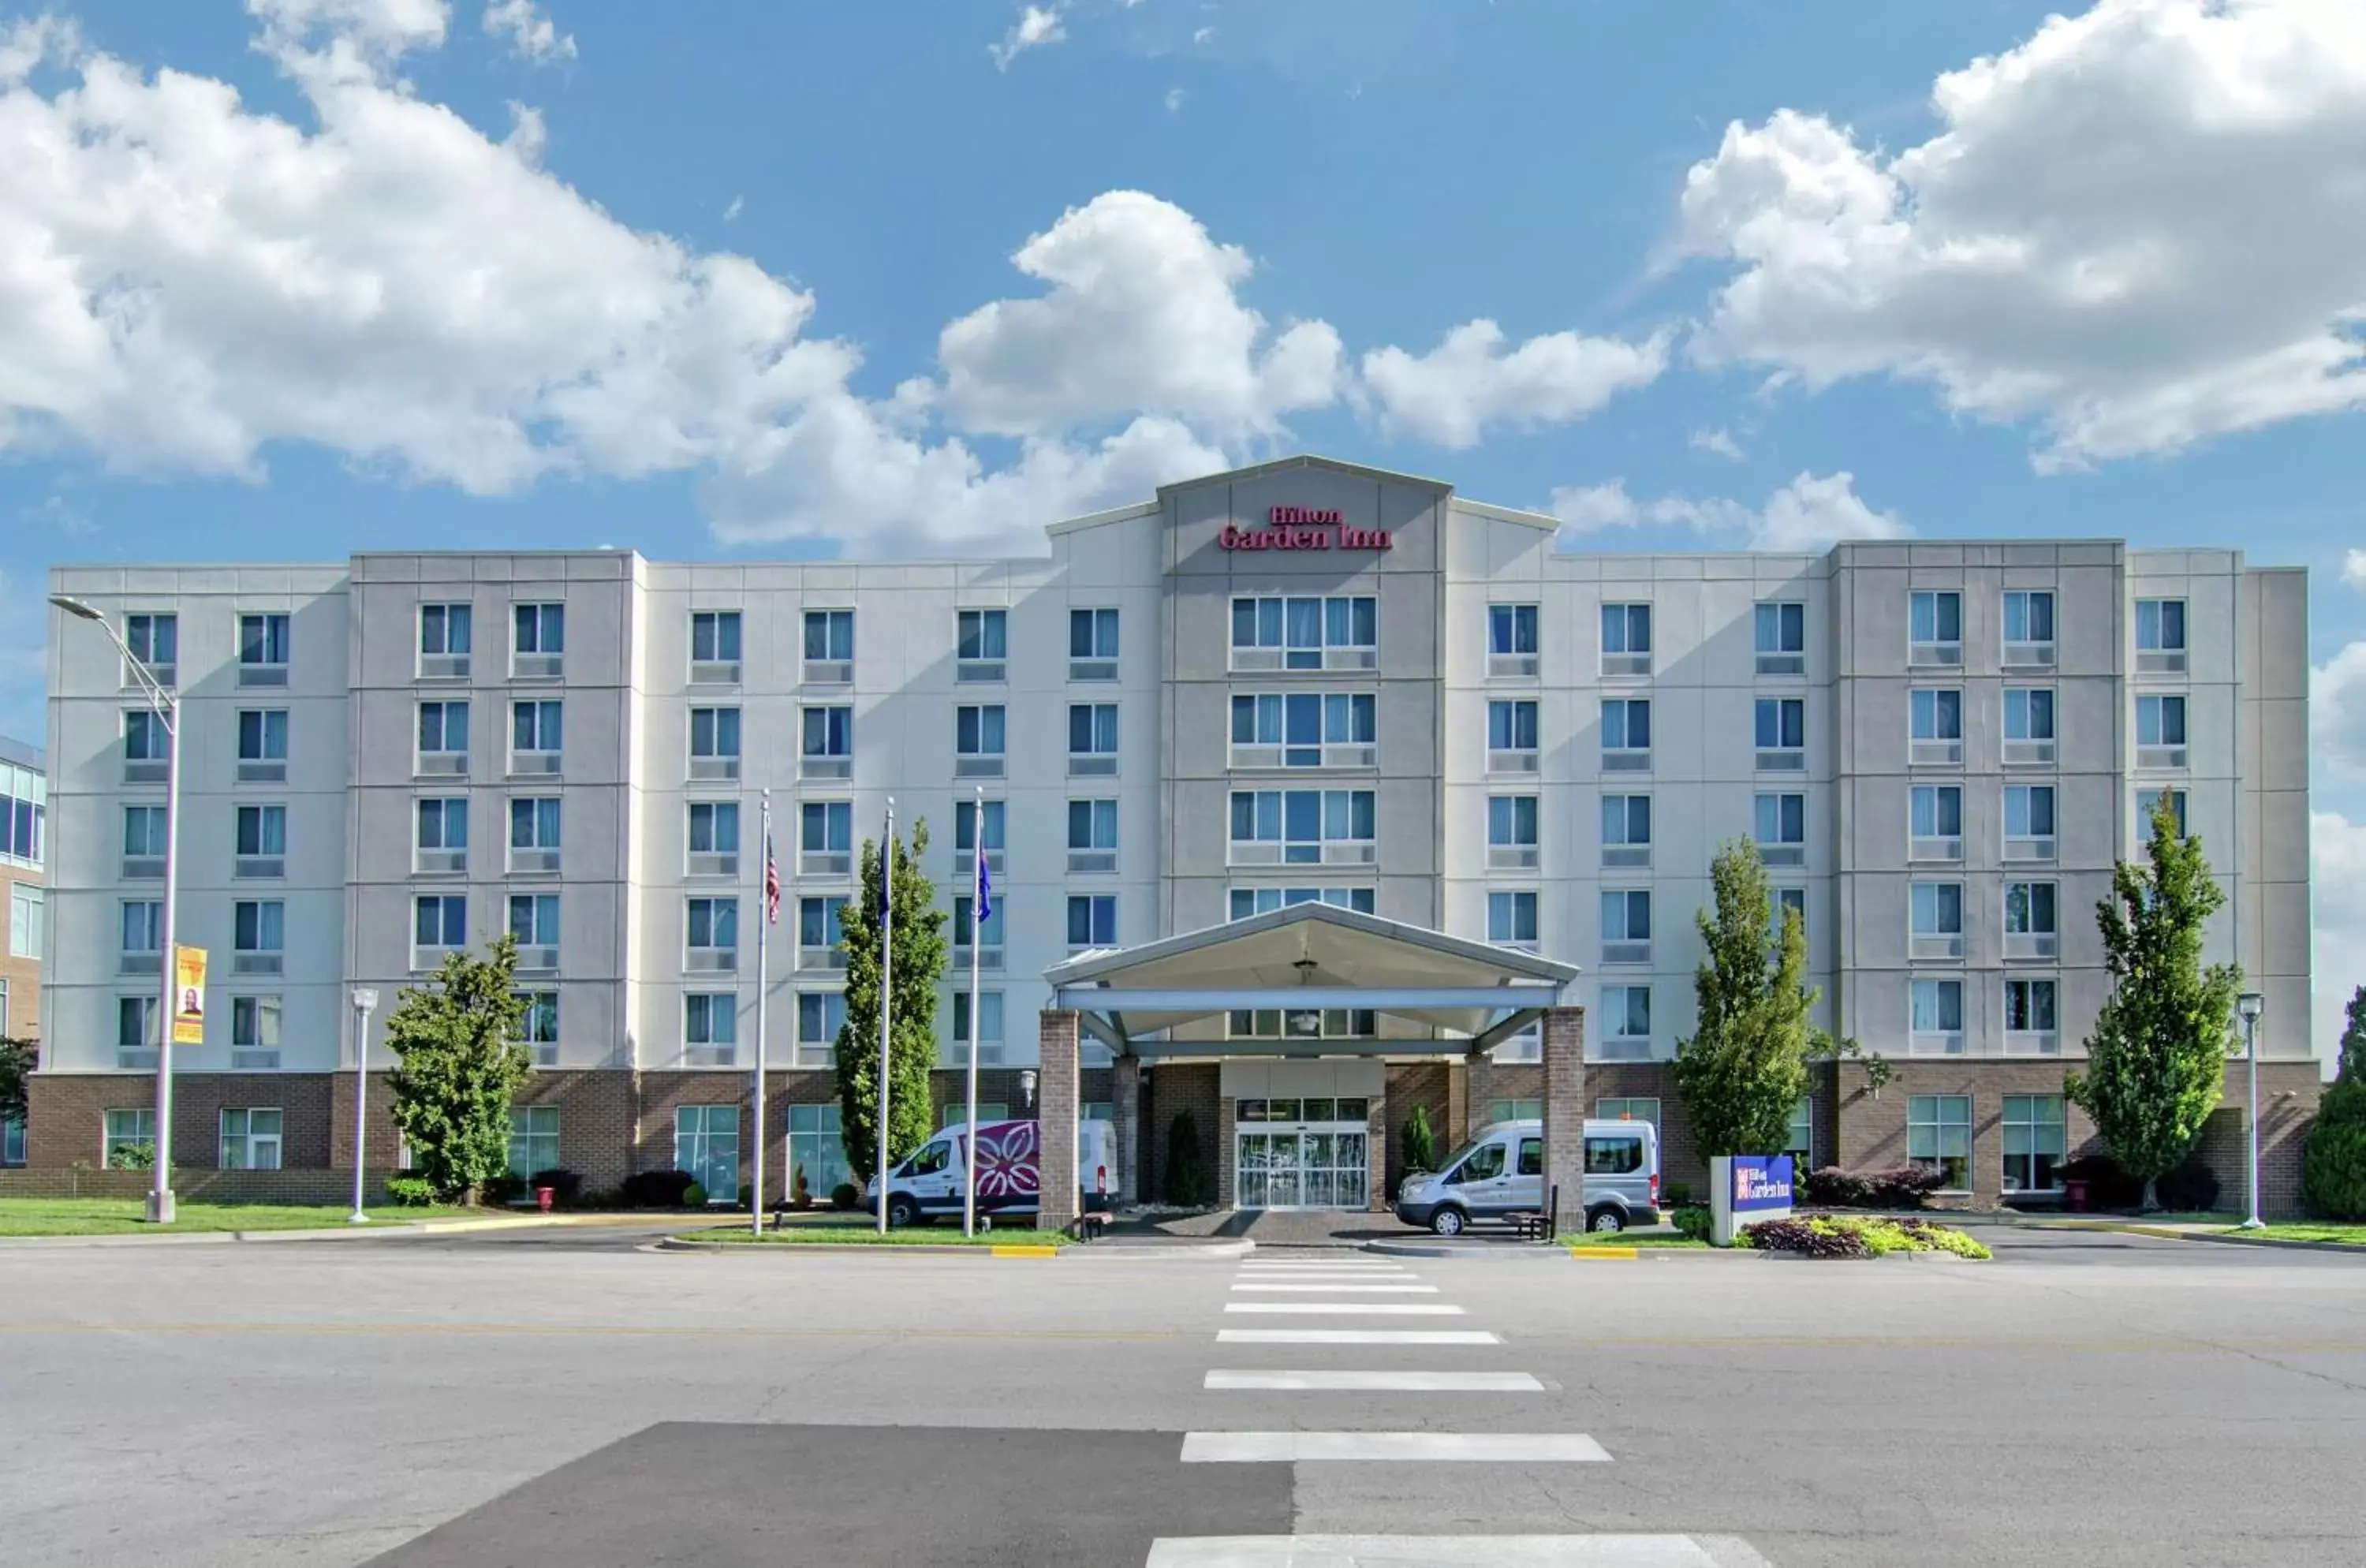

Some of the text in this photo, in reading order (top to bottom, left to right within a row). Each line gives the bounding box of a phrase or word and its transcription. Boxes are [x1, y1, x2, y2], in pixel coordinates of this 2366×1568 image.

[1270, 505, 1342, 524] Hilton
[1219, 524, 1393, 550] Garden Inn
